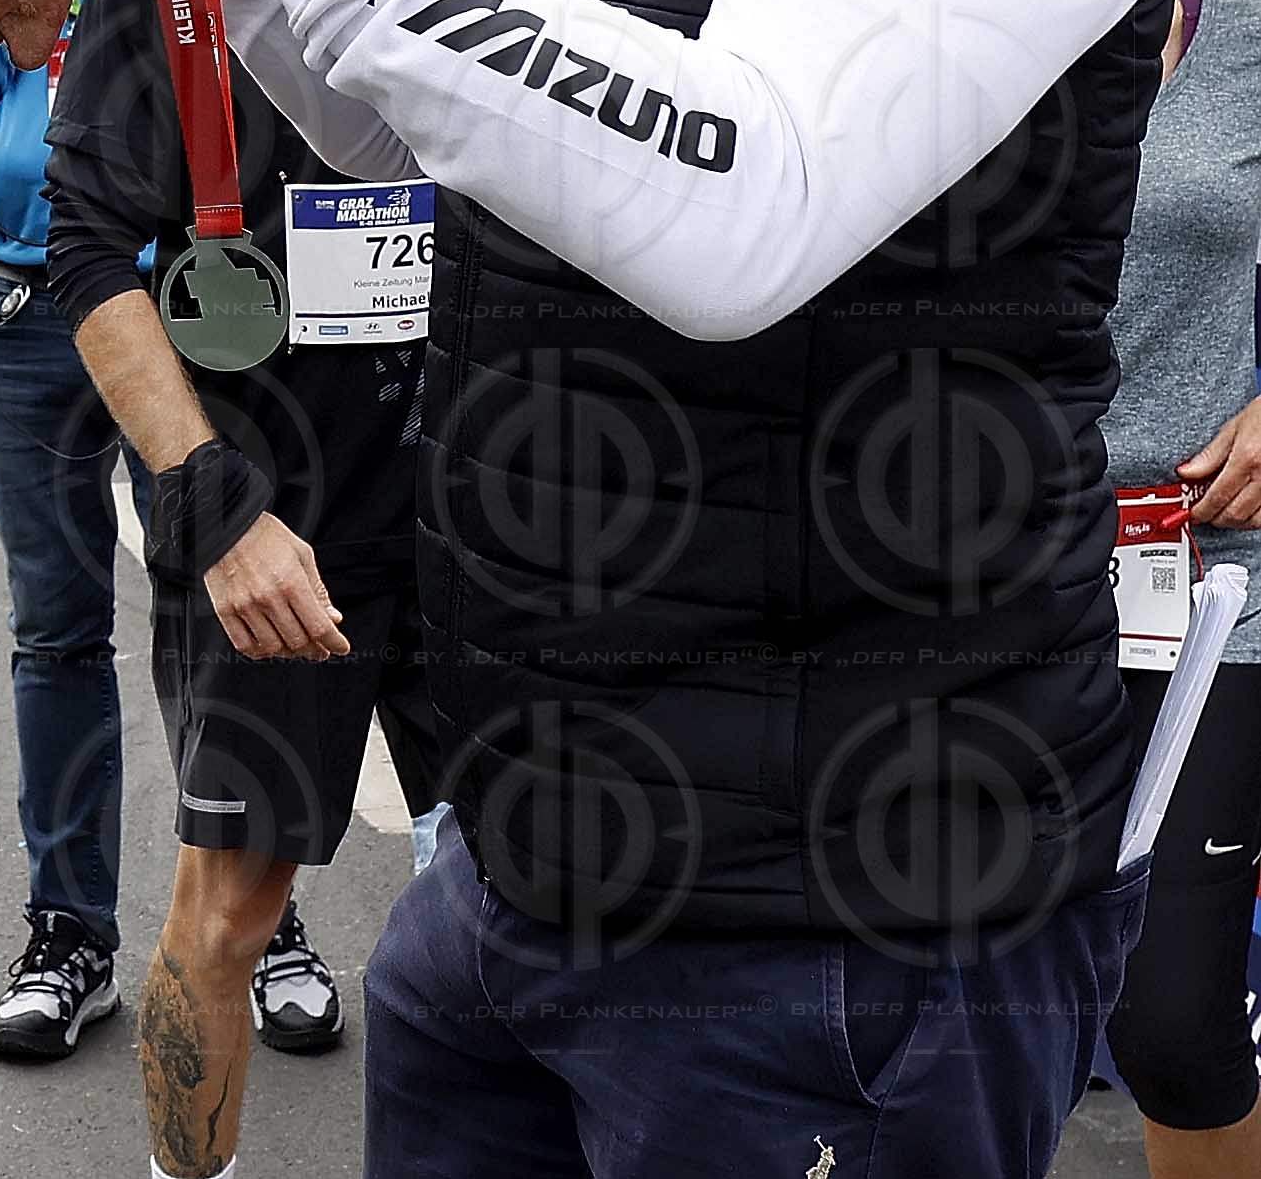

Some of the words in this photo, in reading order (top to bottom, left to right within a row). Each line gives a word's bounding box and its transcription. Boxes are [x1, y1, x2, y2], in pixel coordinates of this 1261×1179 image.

[338, 197, 375, 210] GRAZ
[336, 205, 410, 222] MARATHON
[365, 231, 435, 270] 726
